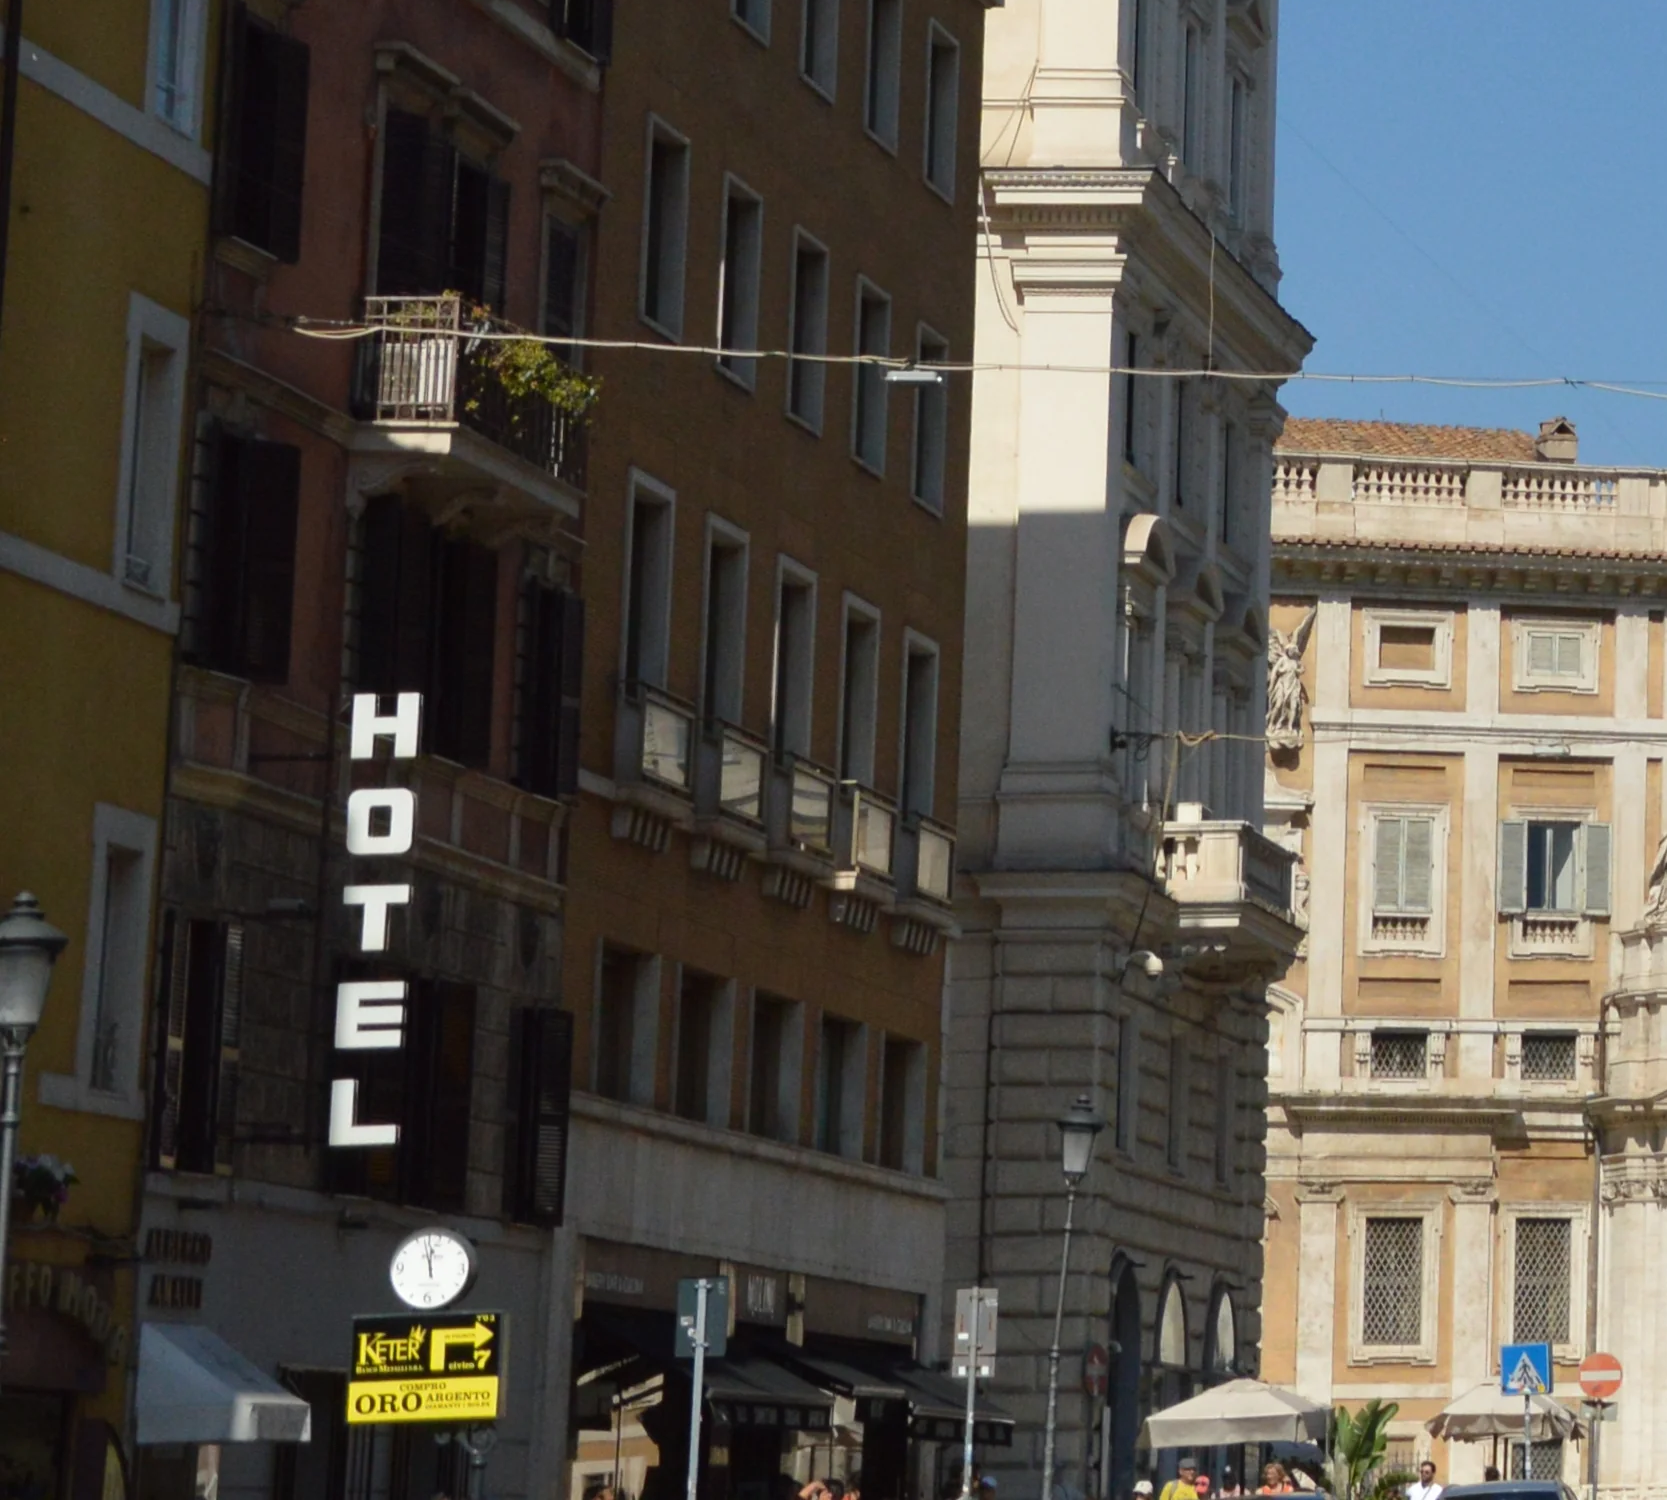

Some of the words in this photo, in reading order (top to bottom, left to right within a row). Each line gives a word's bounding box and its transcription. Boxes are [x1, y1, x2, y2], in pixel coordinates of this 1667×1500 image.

[328, 691, 424, 1146] HOTEL
[396, 1261, 405, 1275] 9
[422, 1291, 432, 1304] 6
[357, 1331, 421, 1366] KETER
[448, 1360, 475, 1371] civico
[474, 1349, 492, 1370] 7
[399, 1382, 447, 1392] COMPRO
[355, 1391, 423, 1416] ORO
[426, 1391, 491, 1403] ARGENTO
